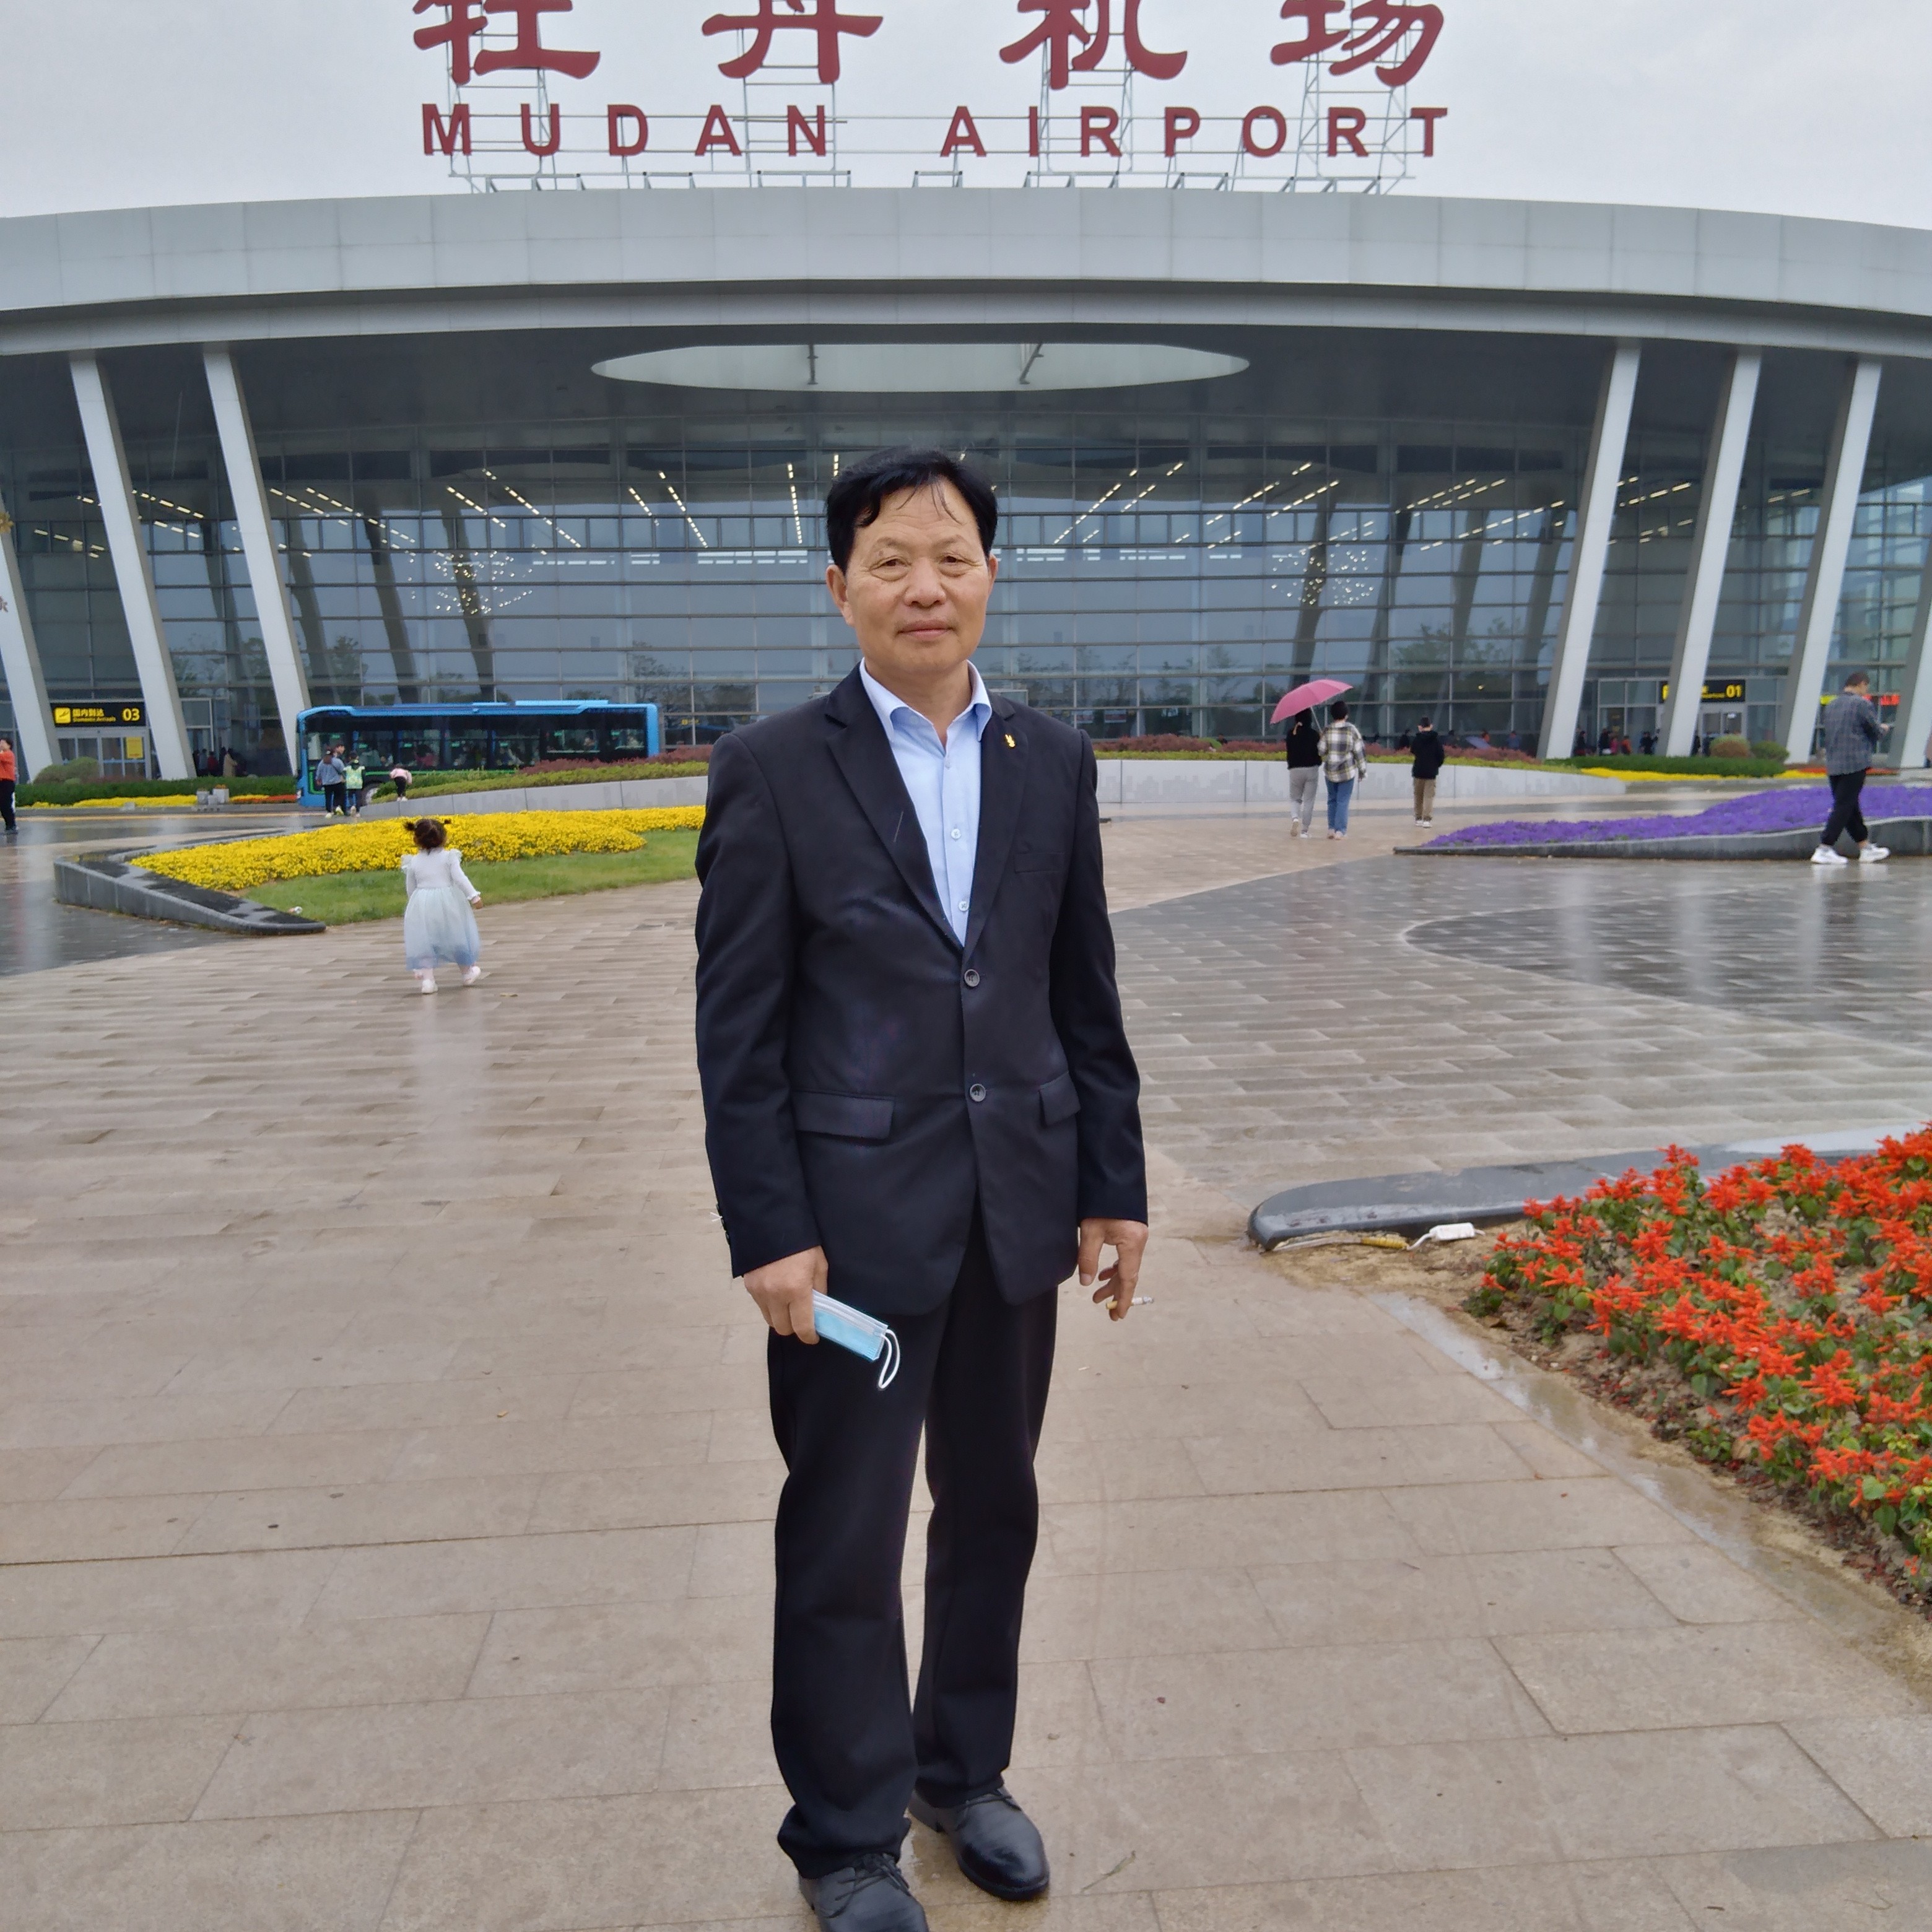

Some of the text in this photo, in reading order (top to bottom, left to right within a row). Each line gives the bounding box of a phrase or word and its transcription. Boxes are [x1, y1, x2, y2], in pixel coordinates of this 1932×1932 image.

[422, 103, 1448, 158] MUDAN AIRPORT
[1726, 685, 1741, 698] 01
[122, 708, 140, 721] 03
